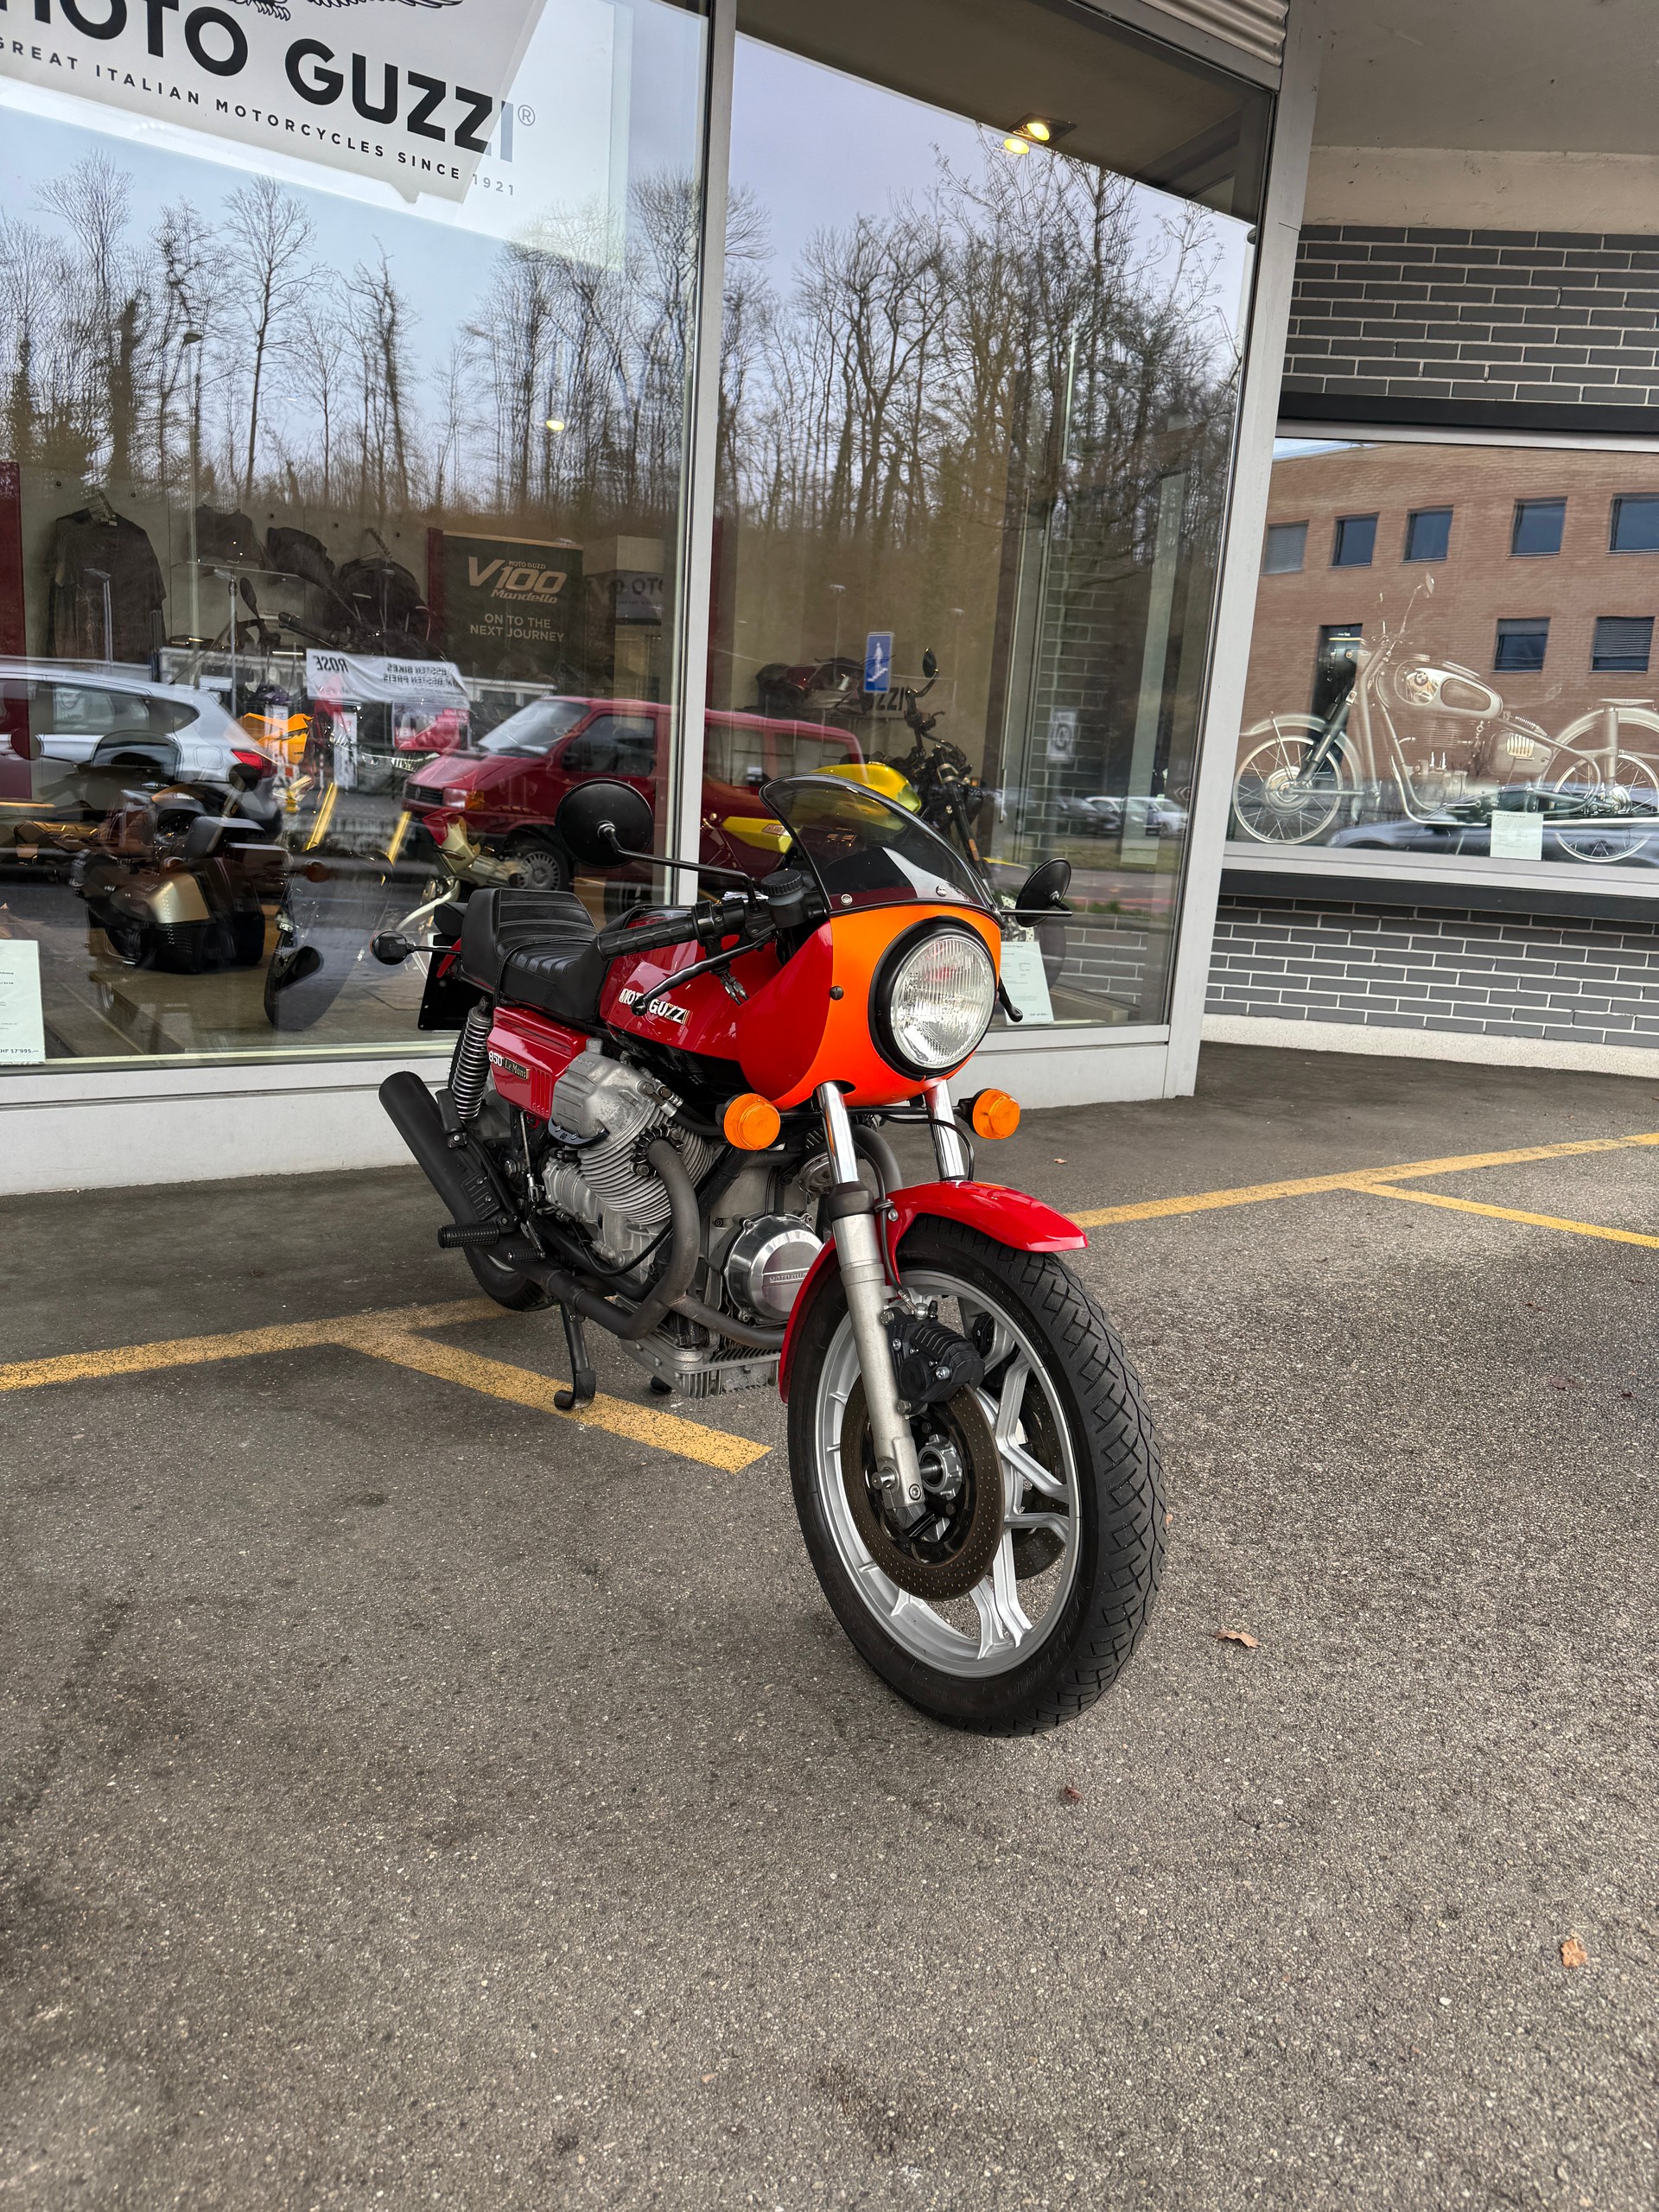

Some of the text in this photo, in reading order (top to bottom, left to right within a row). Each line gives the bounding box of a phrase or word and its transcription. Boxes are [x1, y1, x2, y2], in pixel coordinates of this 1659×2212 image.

[95, 64, 200, 105] ITALIAN
[215, 99, 384, 157] MOTORCYCLES
[397, 151, 461, 180] SINCE
[472, 173, 514, 196] 1921
[468, 556, 568, 594] V100
[491, 588, 558, 604] Mandello
[485, 613, 551, 629] ON TO THE
[469, 624, 565, 643] NEXT JOURNEY
[619, 988, 645, 1006] MOT
[488, 1050, 503, 1067] 850
